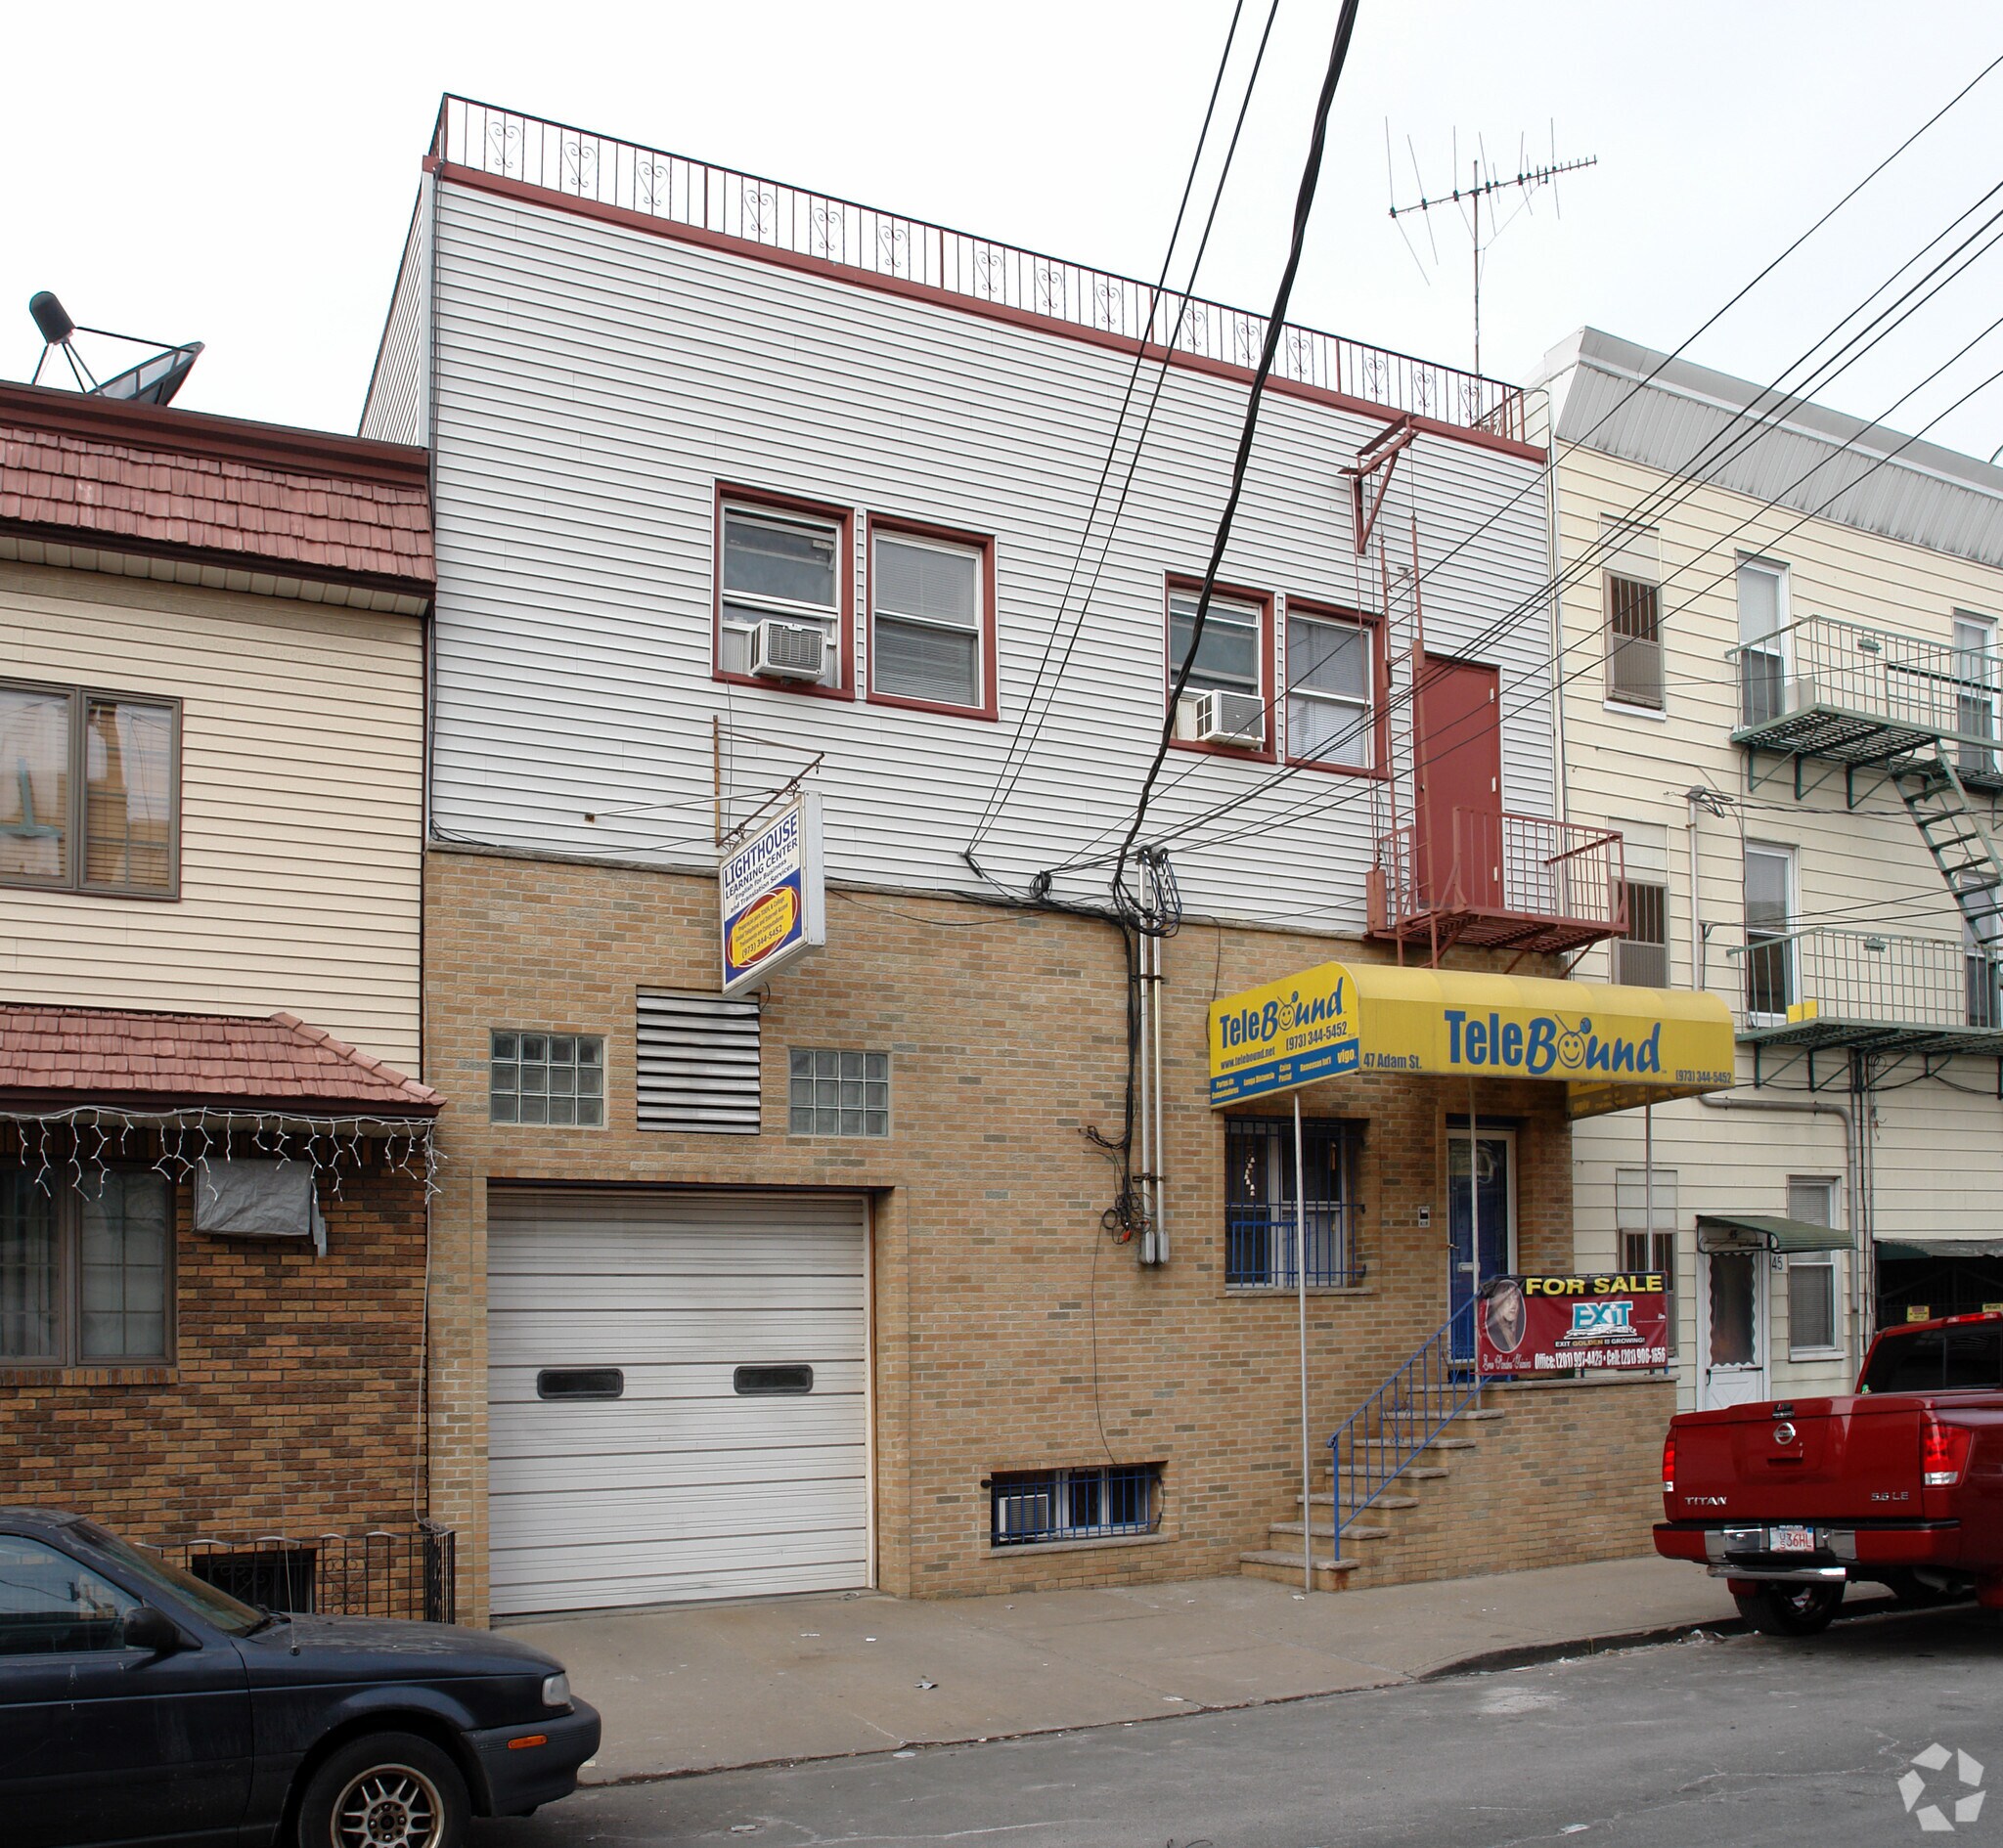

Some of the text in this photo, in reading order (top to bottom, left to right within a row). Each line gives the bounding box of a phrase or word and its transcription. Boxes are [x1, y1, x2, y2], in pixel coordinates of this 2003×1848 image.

[725, 814, 797, 888] LIGHTHOUSE
[726, 838, 798, 900] LEARNING CENTER
[735, 884, 753, 901] English
[764, 858, 787, 879] Business
[731, 863, 793, 913] and Translation Services
[742, 943, 756, 959] (973)
[757, 924, 782, 947] 344-5452
[1286, 1021, 1347, 1051] (973) 344-5452
[1221, 1047, 1275, 1070] www.telebound.net
[1363, 1052, 1422, 1070] 47 Adam St.
[1675, 1069, 1731, 1083] (973) 344-5452
[1771, 1255, 1783, 1270] 45
[1526, 1275, 1663, 1296] FOR SALE
[1611, 1337, 1646, 1345] GROWING!
[1535, 1352, 1556, 1370] Office:
[1556, 1352, 1574, 1369] (201)
[1621, 1348, 1636, 1365] (201)
[1684, 1496, 1727, 1506] TITAN
[1892, 1491, 1909, 1501] LE
